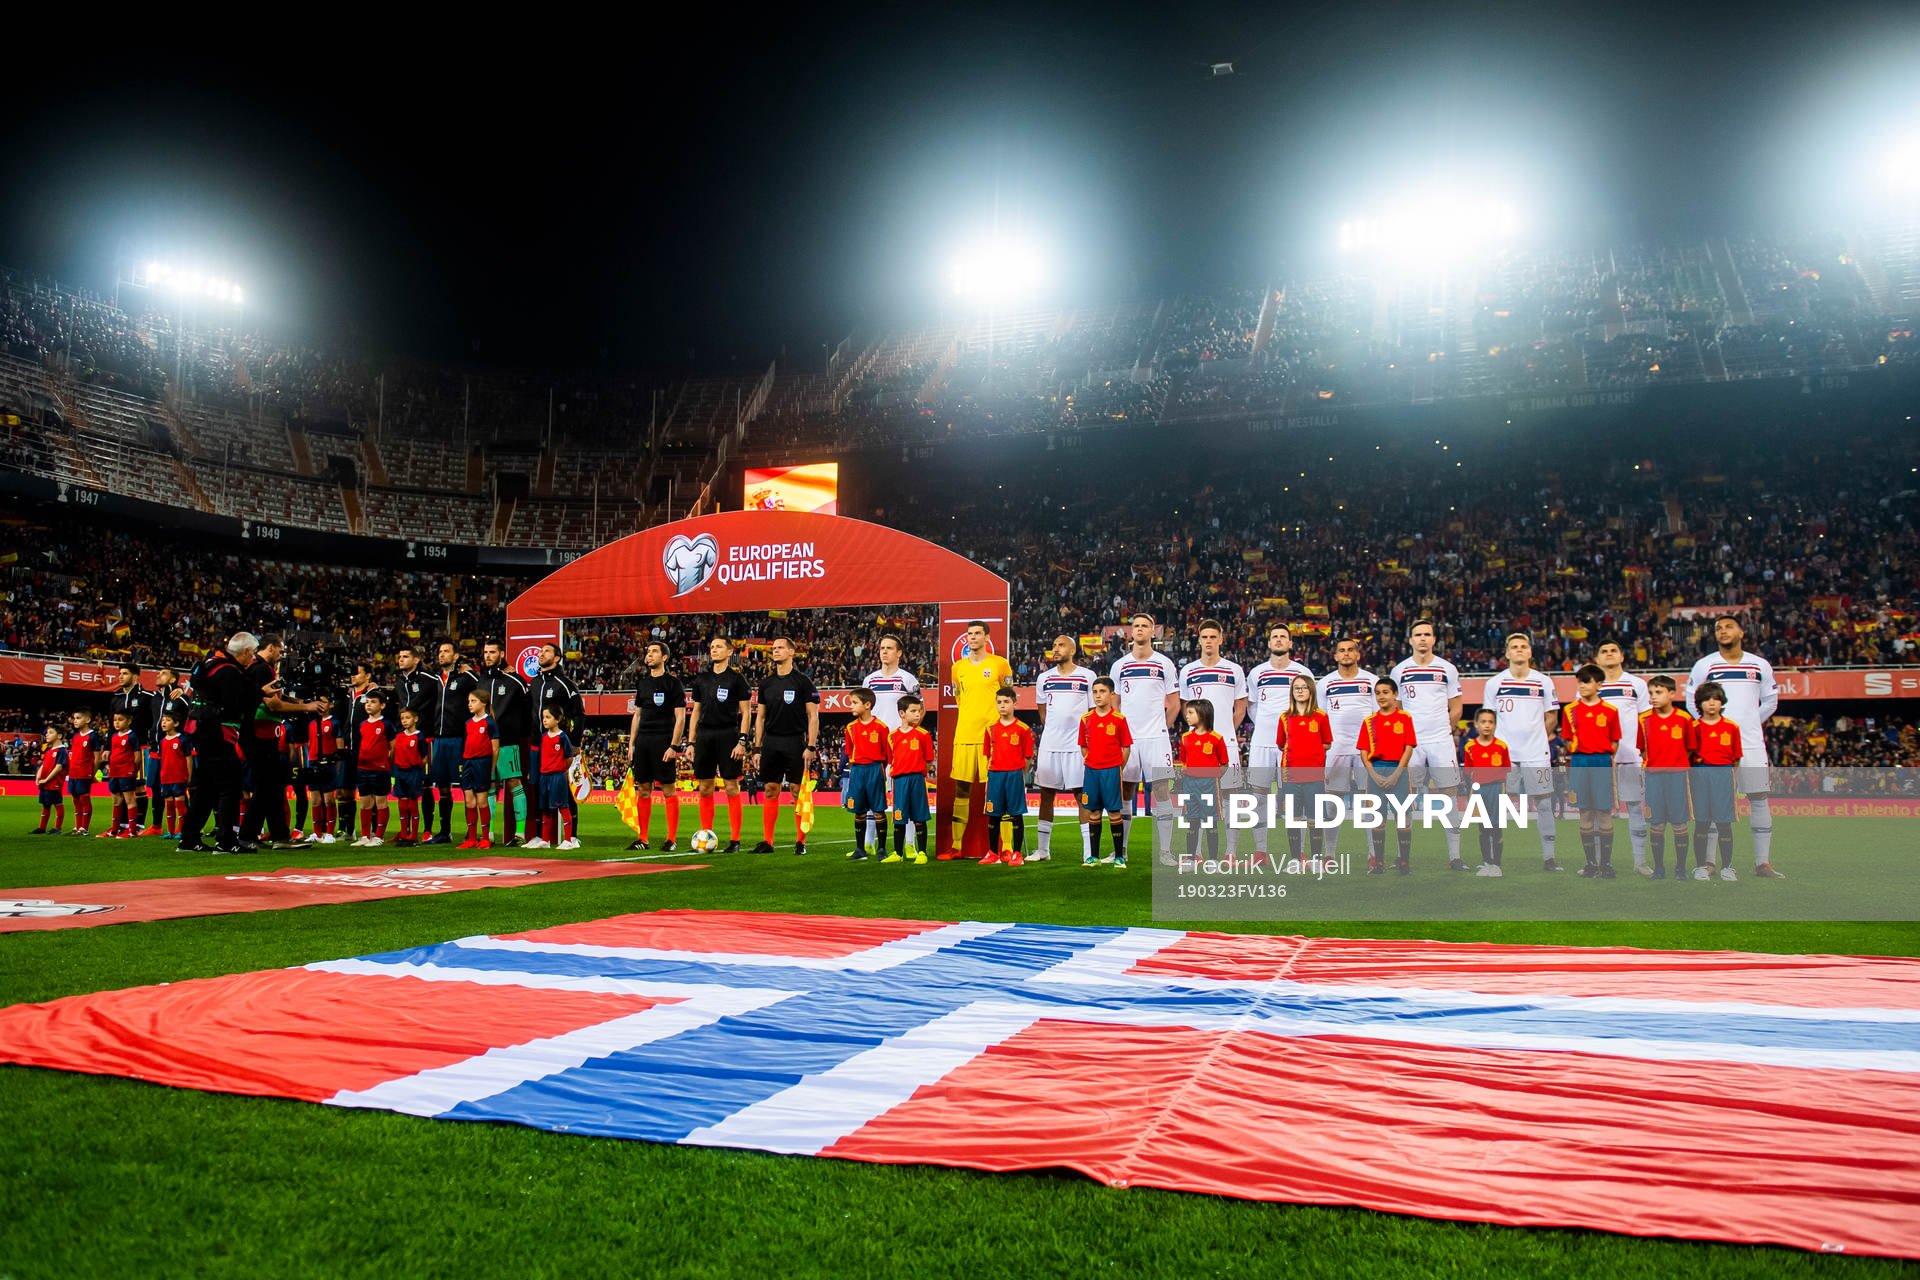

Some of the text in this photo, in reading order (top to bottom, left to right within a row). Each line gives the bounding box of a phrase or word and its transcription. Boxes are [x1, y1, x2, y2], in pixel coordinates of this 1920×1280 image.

[1247, 419, 1270, 432] THIS
[1287, 414, 1338, 429] MESTALLA
[74, 489, 99, 505] 1947
[256, 526, 280, 540] 1949
[423, 545, 447, 558] 1954
[729, 542, 814, 562] EUROPEAN
[718, 558, 825, 585] QUALIFIERS
[1123, 680, 1130, 693] 3
[1192, 686, 1203, 699] 19
[1404, 685, 1416, 698] 18
[1260, 688, 1267, 701] 6
[1498, 698, 1514, 713] 20
[1165, 753, 1172, 767] 3
[1536, 768, 1550, 784] 20
[1791, 802, 1831, 816] volar
[1834, 803, 1849, 816] el
[1852, 803, 1911, 816] talento
